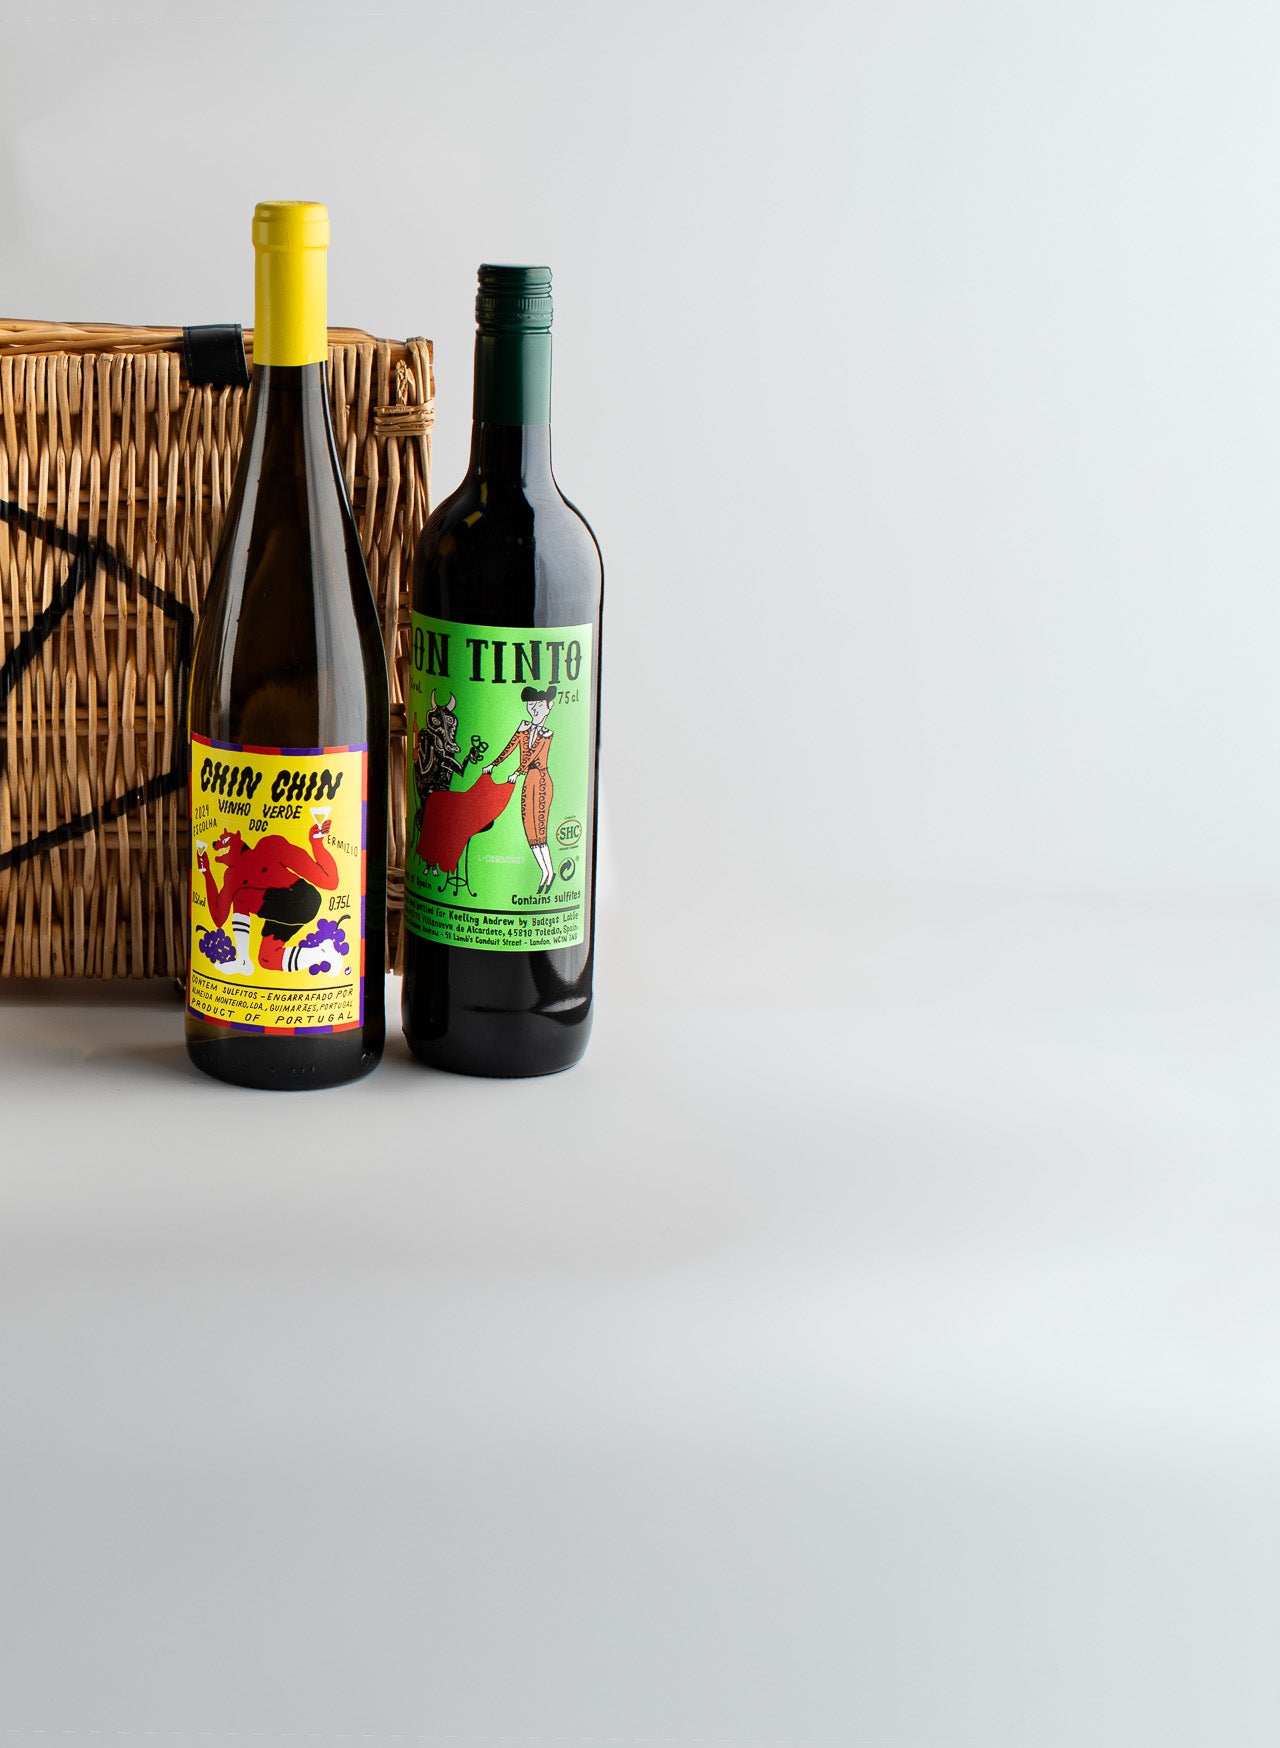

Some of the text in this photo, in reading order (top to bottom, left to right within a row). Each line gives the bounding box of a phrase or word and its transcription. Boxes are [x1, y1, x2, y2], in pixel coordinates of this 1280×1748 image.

[409, 627, 582, 684] ON TINTO
[201, 758, 343, 802] CHIN CHIN
[218, 798, 303, 819] VINHO VERDE
[193, 818, 217, 837] ESCOLHA
[249, 819, 268, 832] DOC
[559, 825, 580, 841] SHC
[327, 834, 358, 857] ERMIZIO
[511, 890, 581, 905] Contains sulfites
[436, 907, 446, 918] for
[448, 910, 479, 926] Keeling
[483, 916, 514, 925] Andrew
[518, 918, 528, 928] by
[532, 916, 559, 927] Bodegas
[453, 933, 473, 943] Lamb's
[475, 936, 500, 946] Conduit
[502, 938, 522, 946] Street
[456, 924, 465, 932] de
[508, 928, 533, 938] 45810
[535, 927, 562, 937] Toledo,
[192, 974, 218, 991] CONTEM
[222, 986, 258, 1000] SULFITOS
[267, 992, 333, 1002] ENGARRAFADO
[336, 988, 354, 999] POR
[192, 997, 353, 1025] PRODUCT OF PORTUGAL
[319, 1000, 353, 1011] PORTUGAL
